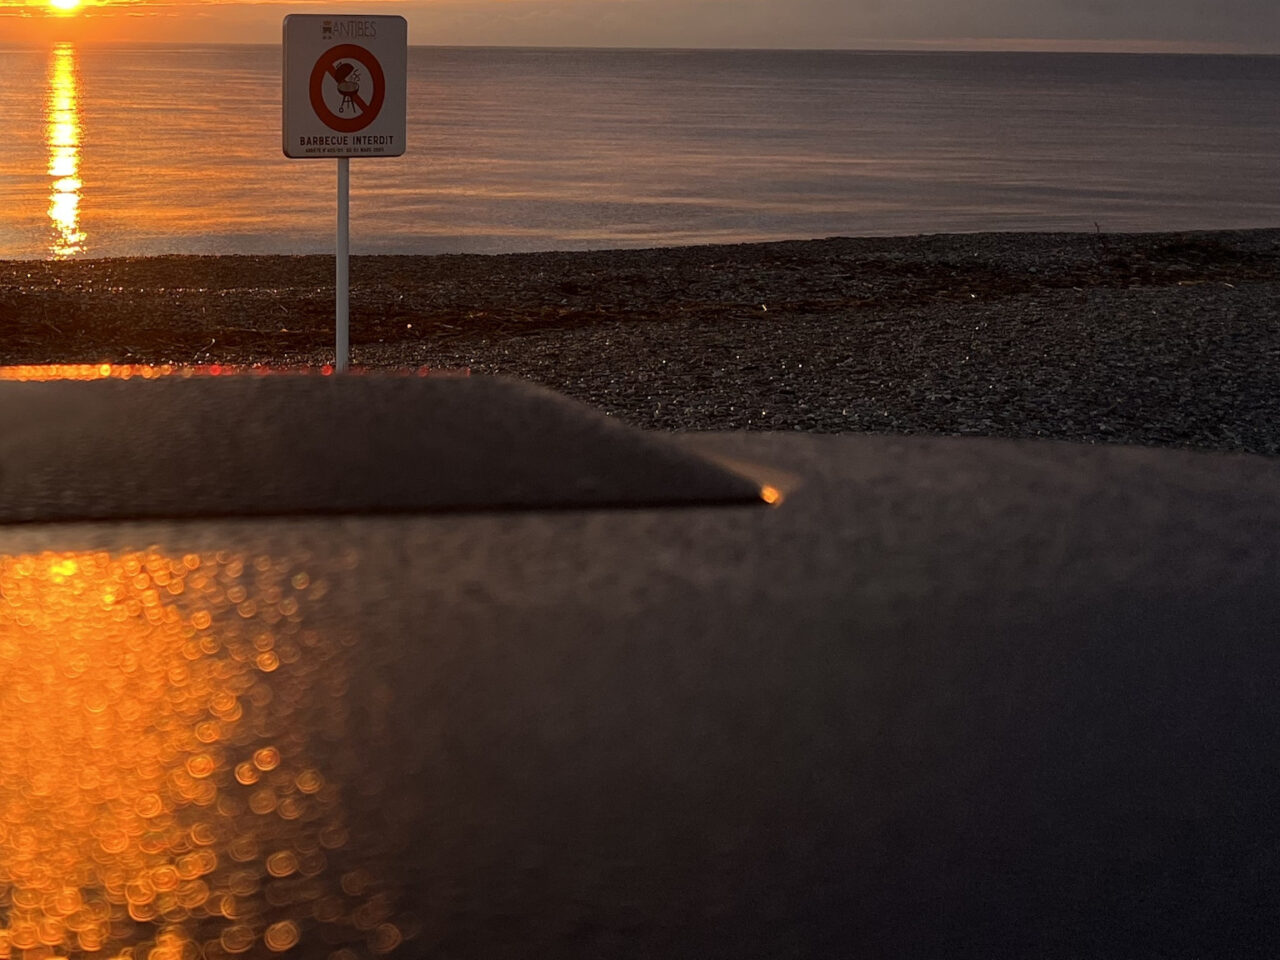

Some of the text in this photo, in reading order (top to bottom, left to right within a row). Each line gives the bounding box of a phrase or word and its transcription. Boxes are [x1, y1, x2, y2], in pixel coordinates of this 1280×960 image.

[333, 20, 377, 38] ANTIBES
[299, 135, 394, 146] BARBECUE INTERDIT
